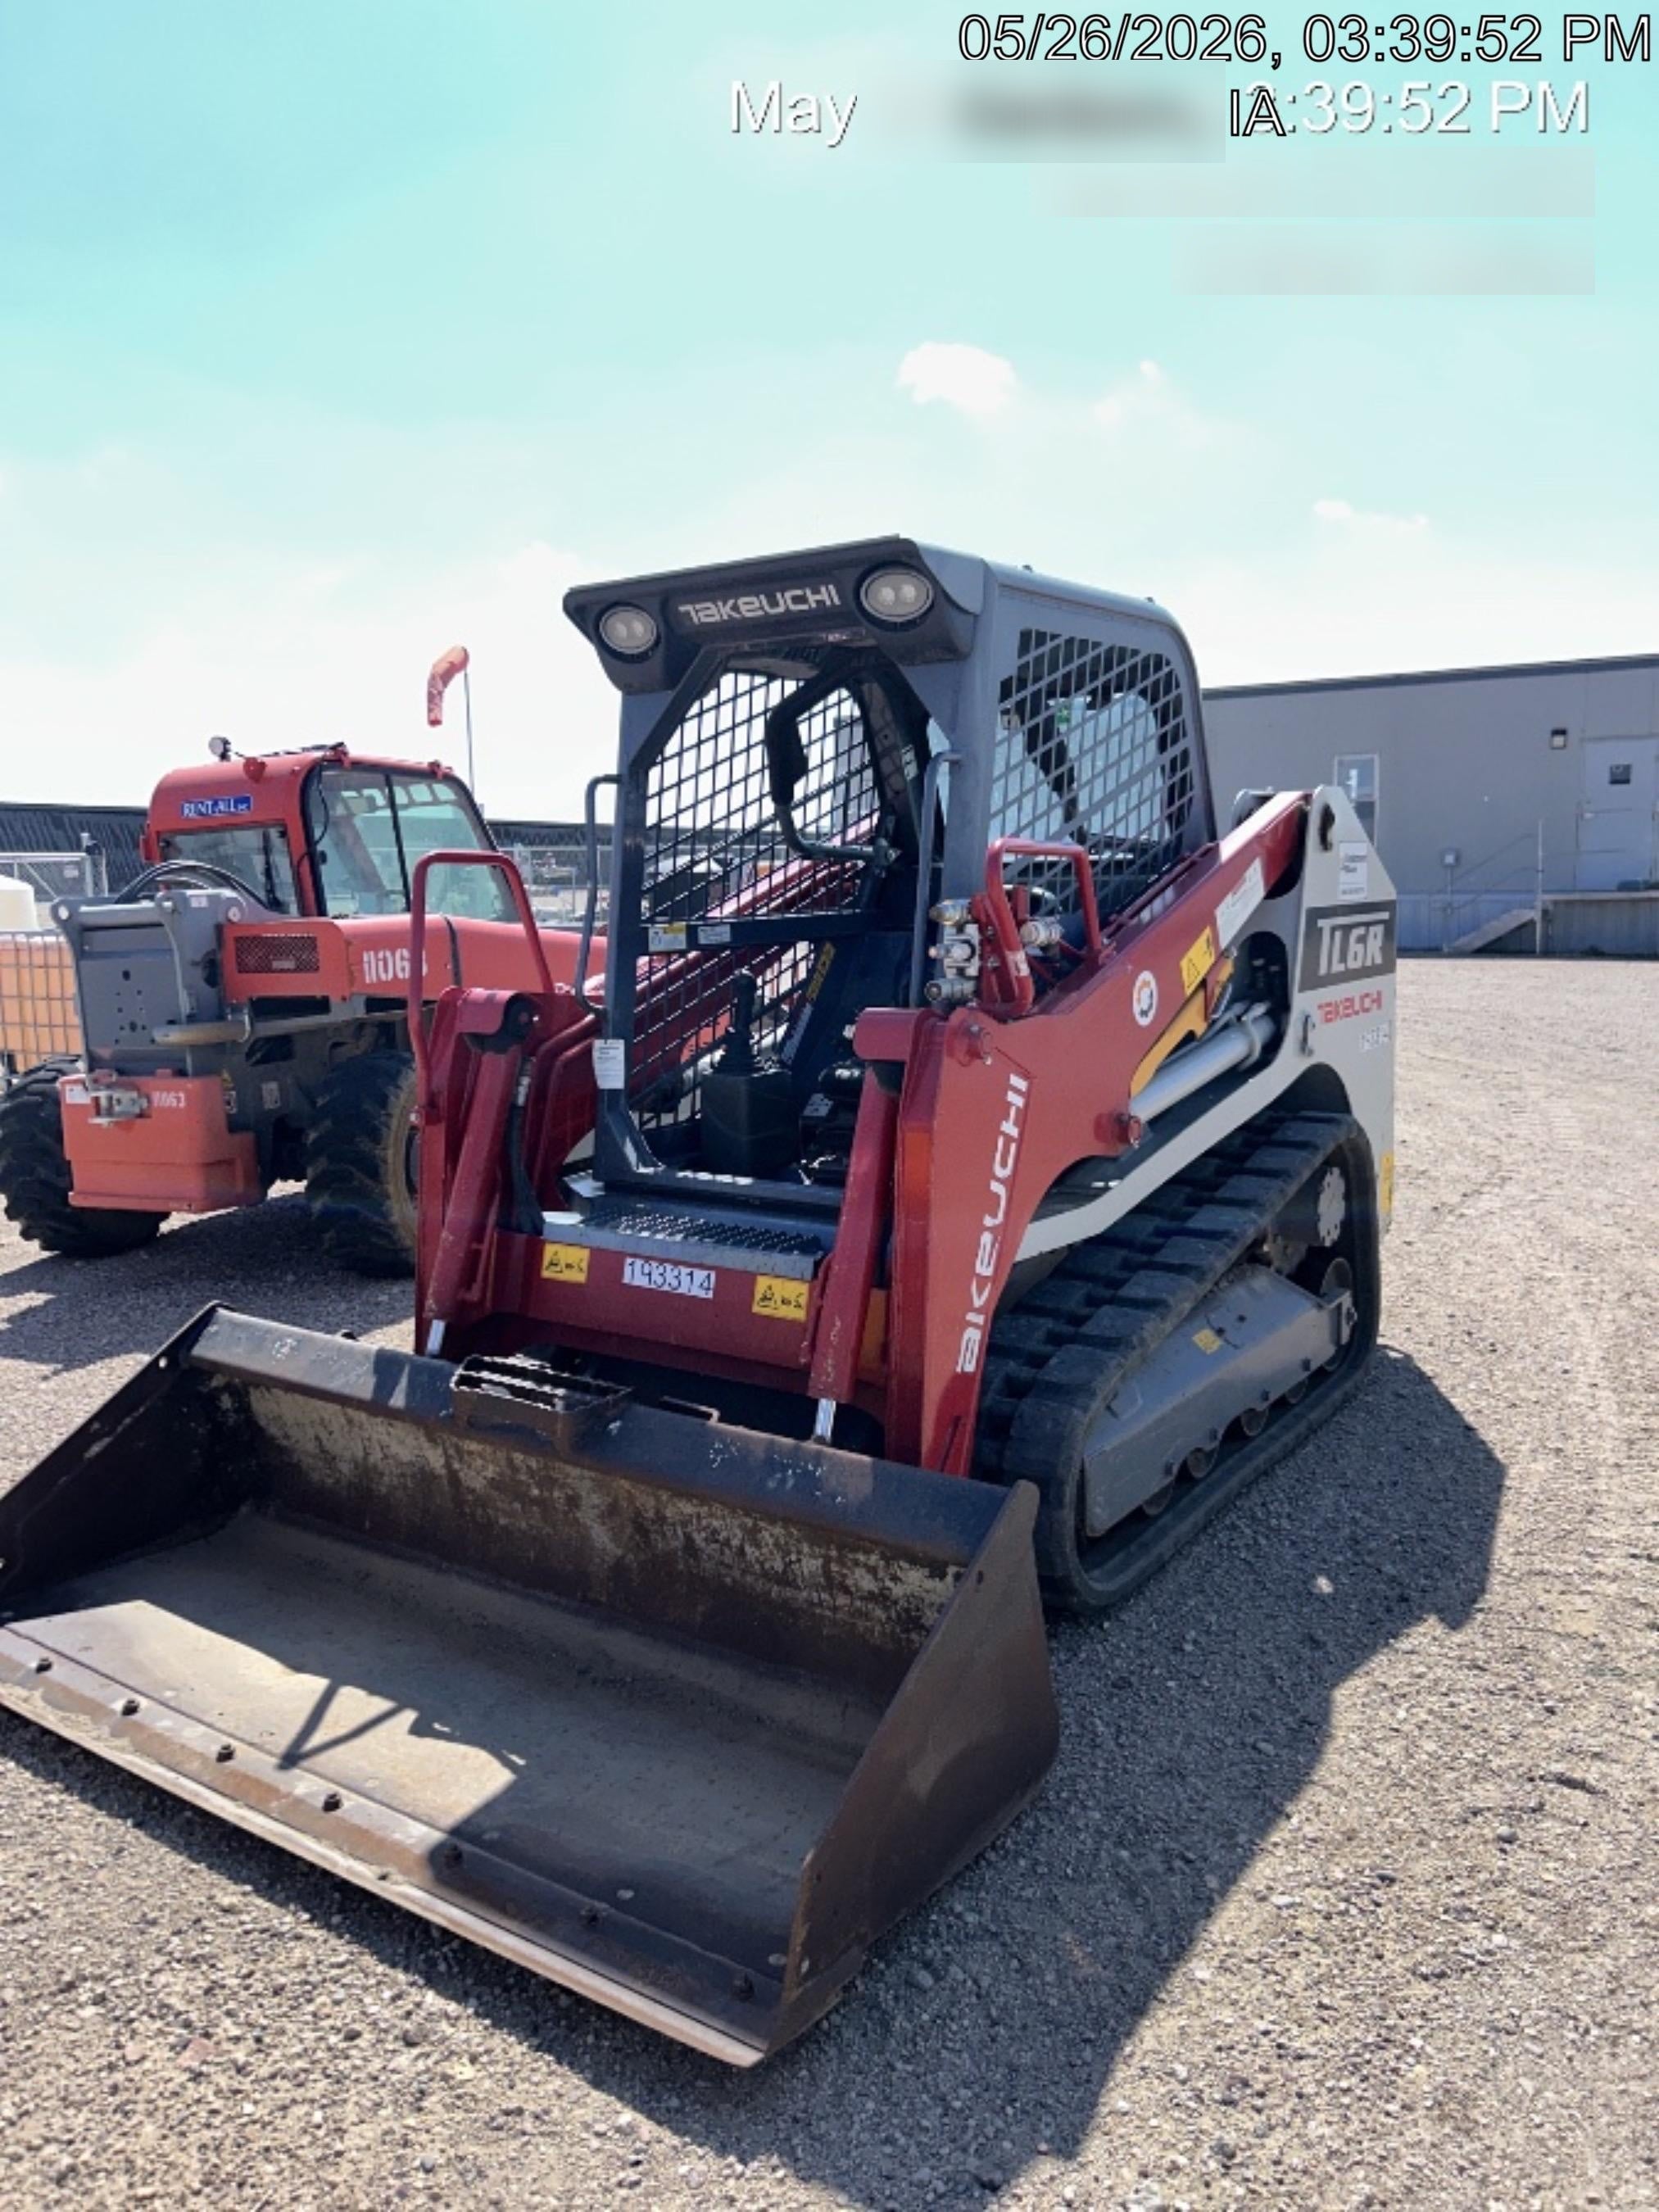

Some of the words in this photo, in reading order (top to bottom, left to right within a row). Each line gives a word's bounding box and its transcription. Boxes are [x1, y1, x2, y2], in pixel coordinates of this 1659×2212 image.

[678, 584, 841, 625] TAKEUCHI
[1317, 911, 1390, 977] TL6R
[628, 1260, 712, 1296] 193314
